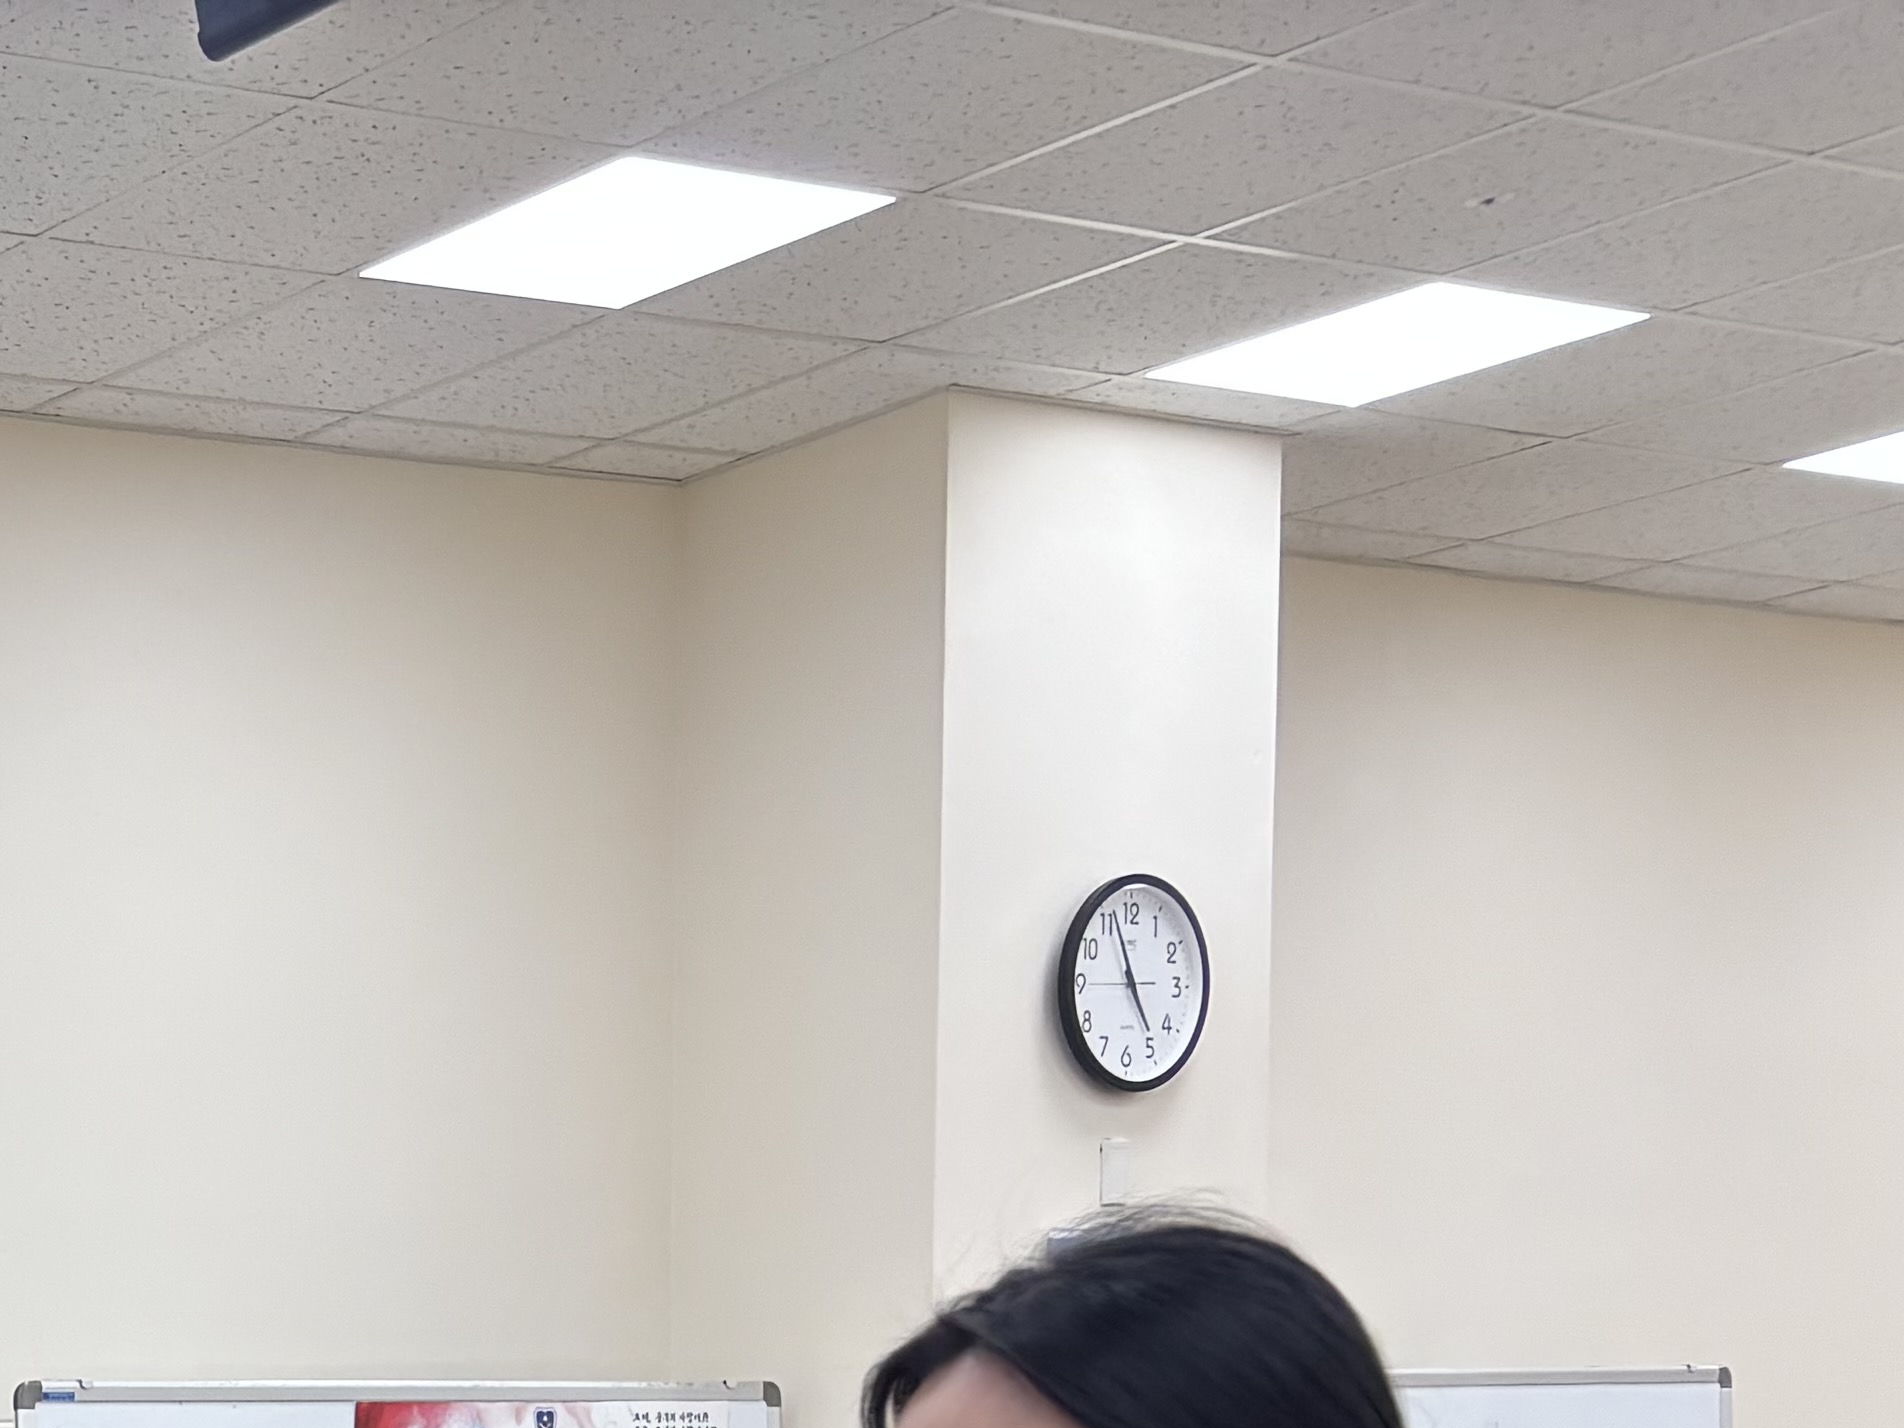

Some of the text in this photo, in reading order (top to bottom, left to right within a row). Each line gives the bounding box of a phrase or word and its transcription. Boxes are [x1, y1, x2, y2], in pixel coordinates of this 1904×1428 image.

[1100, 913, 1113, 936] 11
[1123, 902, 1140, 925] 12
[1153, 915, 1158, 938] 1
[1084, 938, 1098, 960] 10
[1167, 942, 1177, 964] 2
[1075, 973, 1086, 994] 9
[1171, 976, 1182, 998] 3
[1082, 1010, 1091, 1033] 8
[1162, 1013, 1172, 1035] 4
[1099, 1036, 1108, 1057] 7
[1120, 1045, 1132, 1068] 6
[1145, 1037, 1154, 1059] 5
